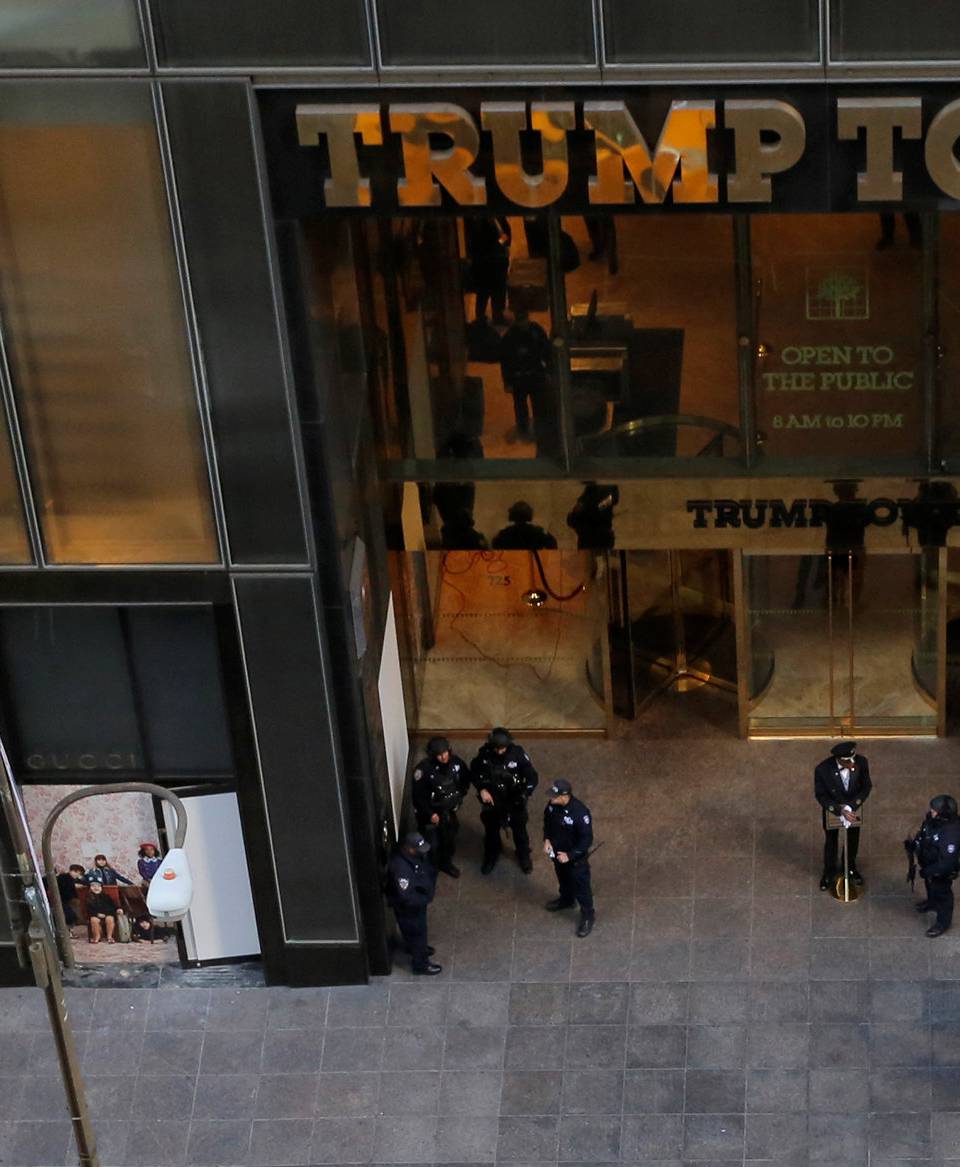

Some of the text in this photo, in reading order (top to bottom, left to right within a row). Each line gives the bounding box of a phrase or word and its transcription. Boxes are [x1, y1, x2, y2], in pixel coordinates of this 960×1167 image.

[295, 99, 806, 208] TRUMP
[781, 346, 894, 365] OPEN TO
[763, 371, 914, 391] THE PUBLIC
[787, 415, 822, 429] AM
[826, 416, 844, 429] to
[872, 414, 904, 428] PM
[686, 500, 832, 528] TRUMP
[27, 753, 137, 770] GUCCI
